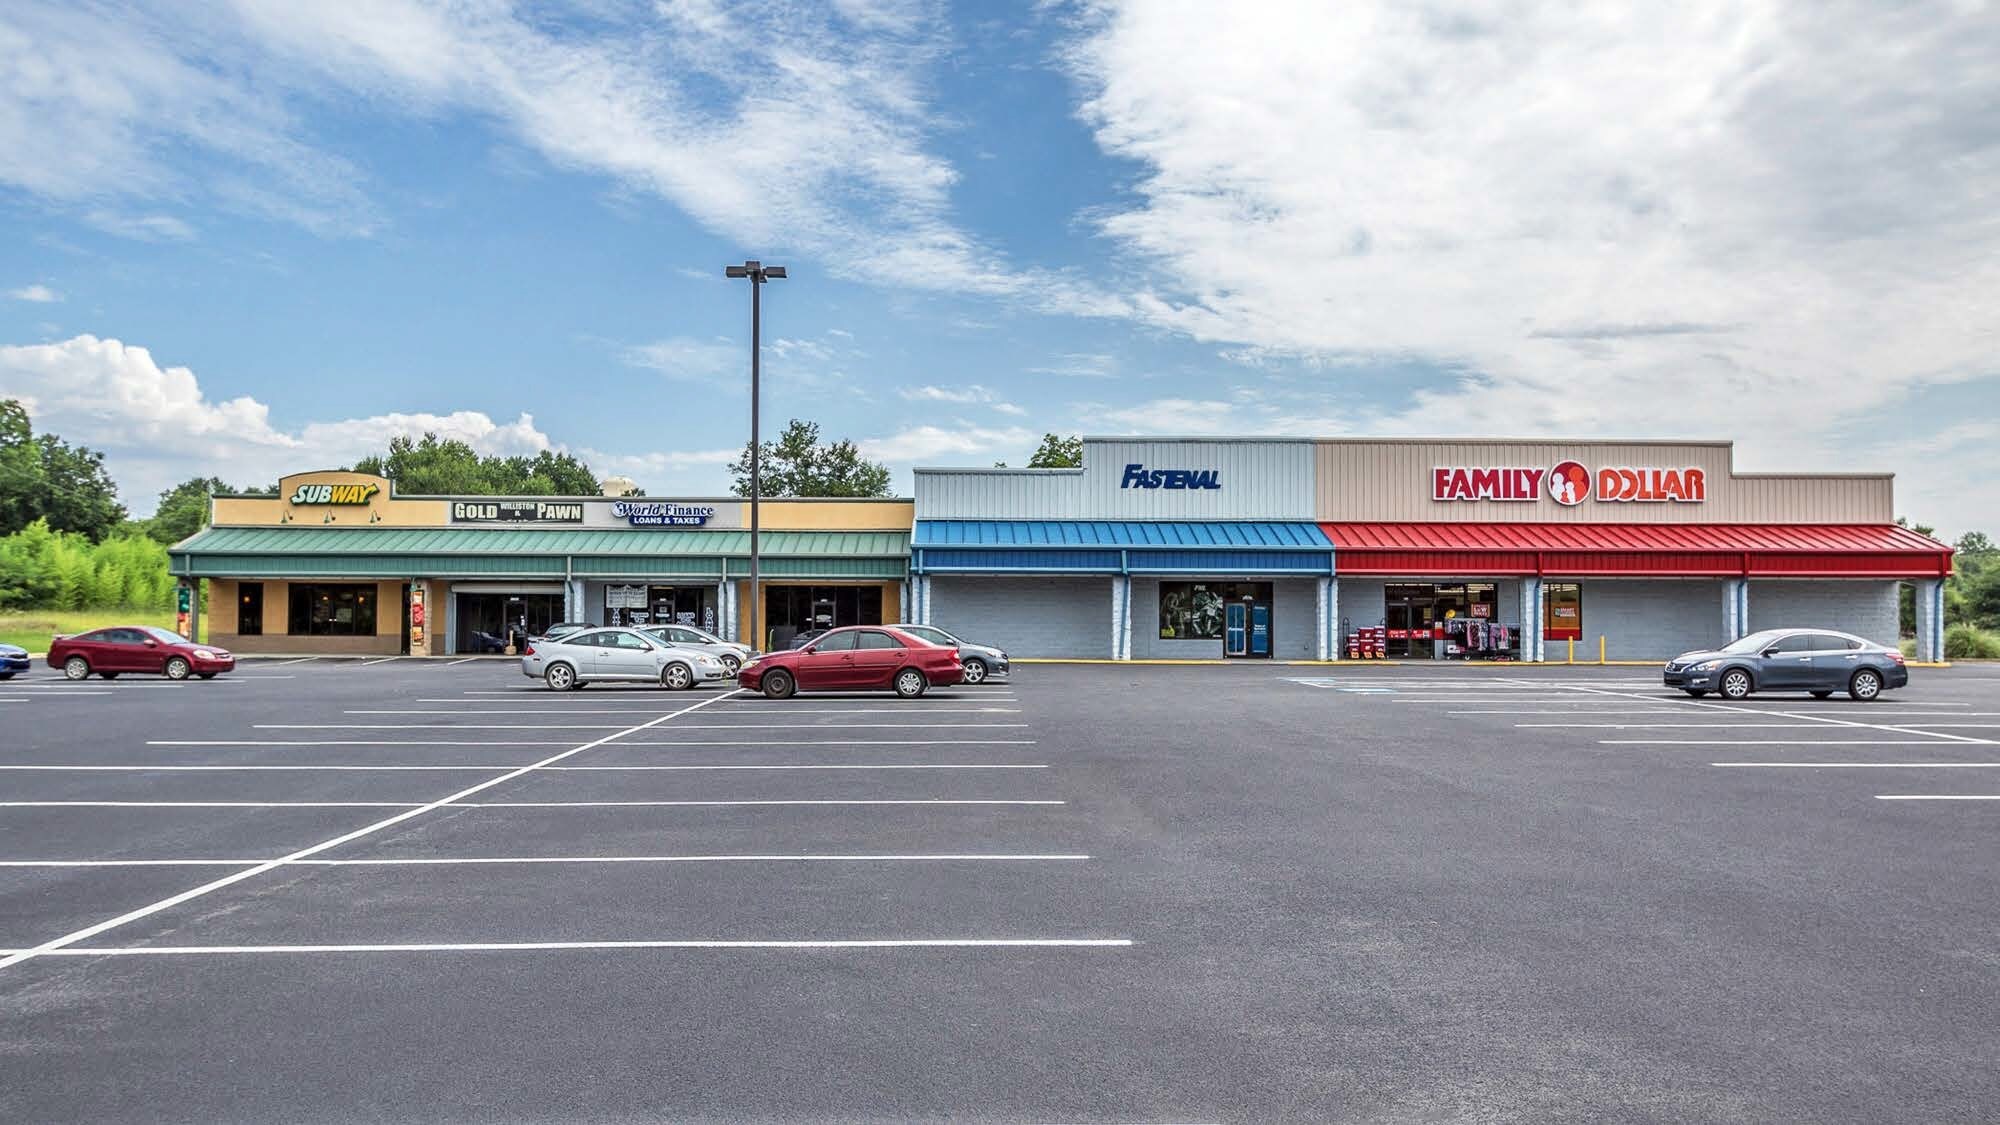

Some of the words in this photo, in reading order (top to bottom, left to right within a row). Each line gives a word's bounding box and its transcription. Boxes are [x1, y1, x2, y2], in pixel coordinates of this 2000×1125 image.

[1120, 464, 1221, 489] FASTENAL
[1434, 468, 1544, 500] FAMILY
[1597, 468, 1705, 501] DOLLAR
[291, 483, 379, 504] SUBWAY
[454, 503, 498, 519] GOLD
[536, 503, 581, 519] PAWN
[500, 502, 535, 510] WILLISTON
[621, 503, 661, 516] World
[663, 503, 714, 516] Finance
[633, 516, 662, 525] LOANS
[663, 517, 671, 525] &
[672, 517, 701, 525] TAXES
